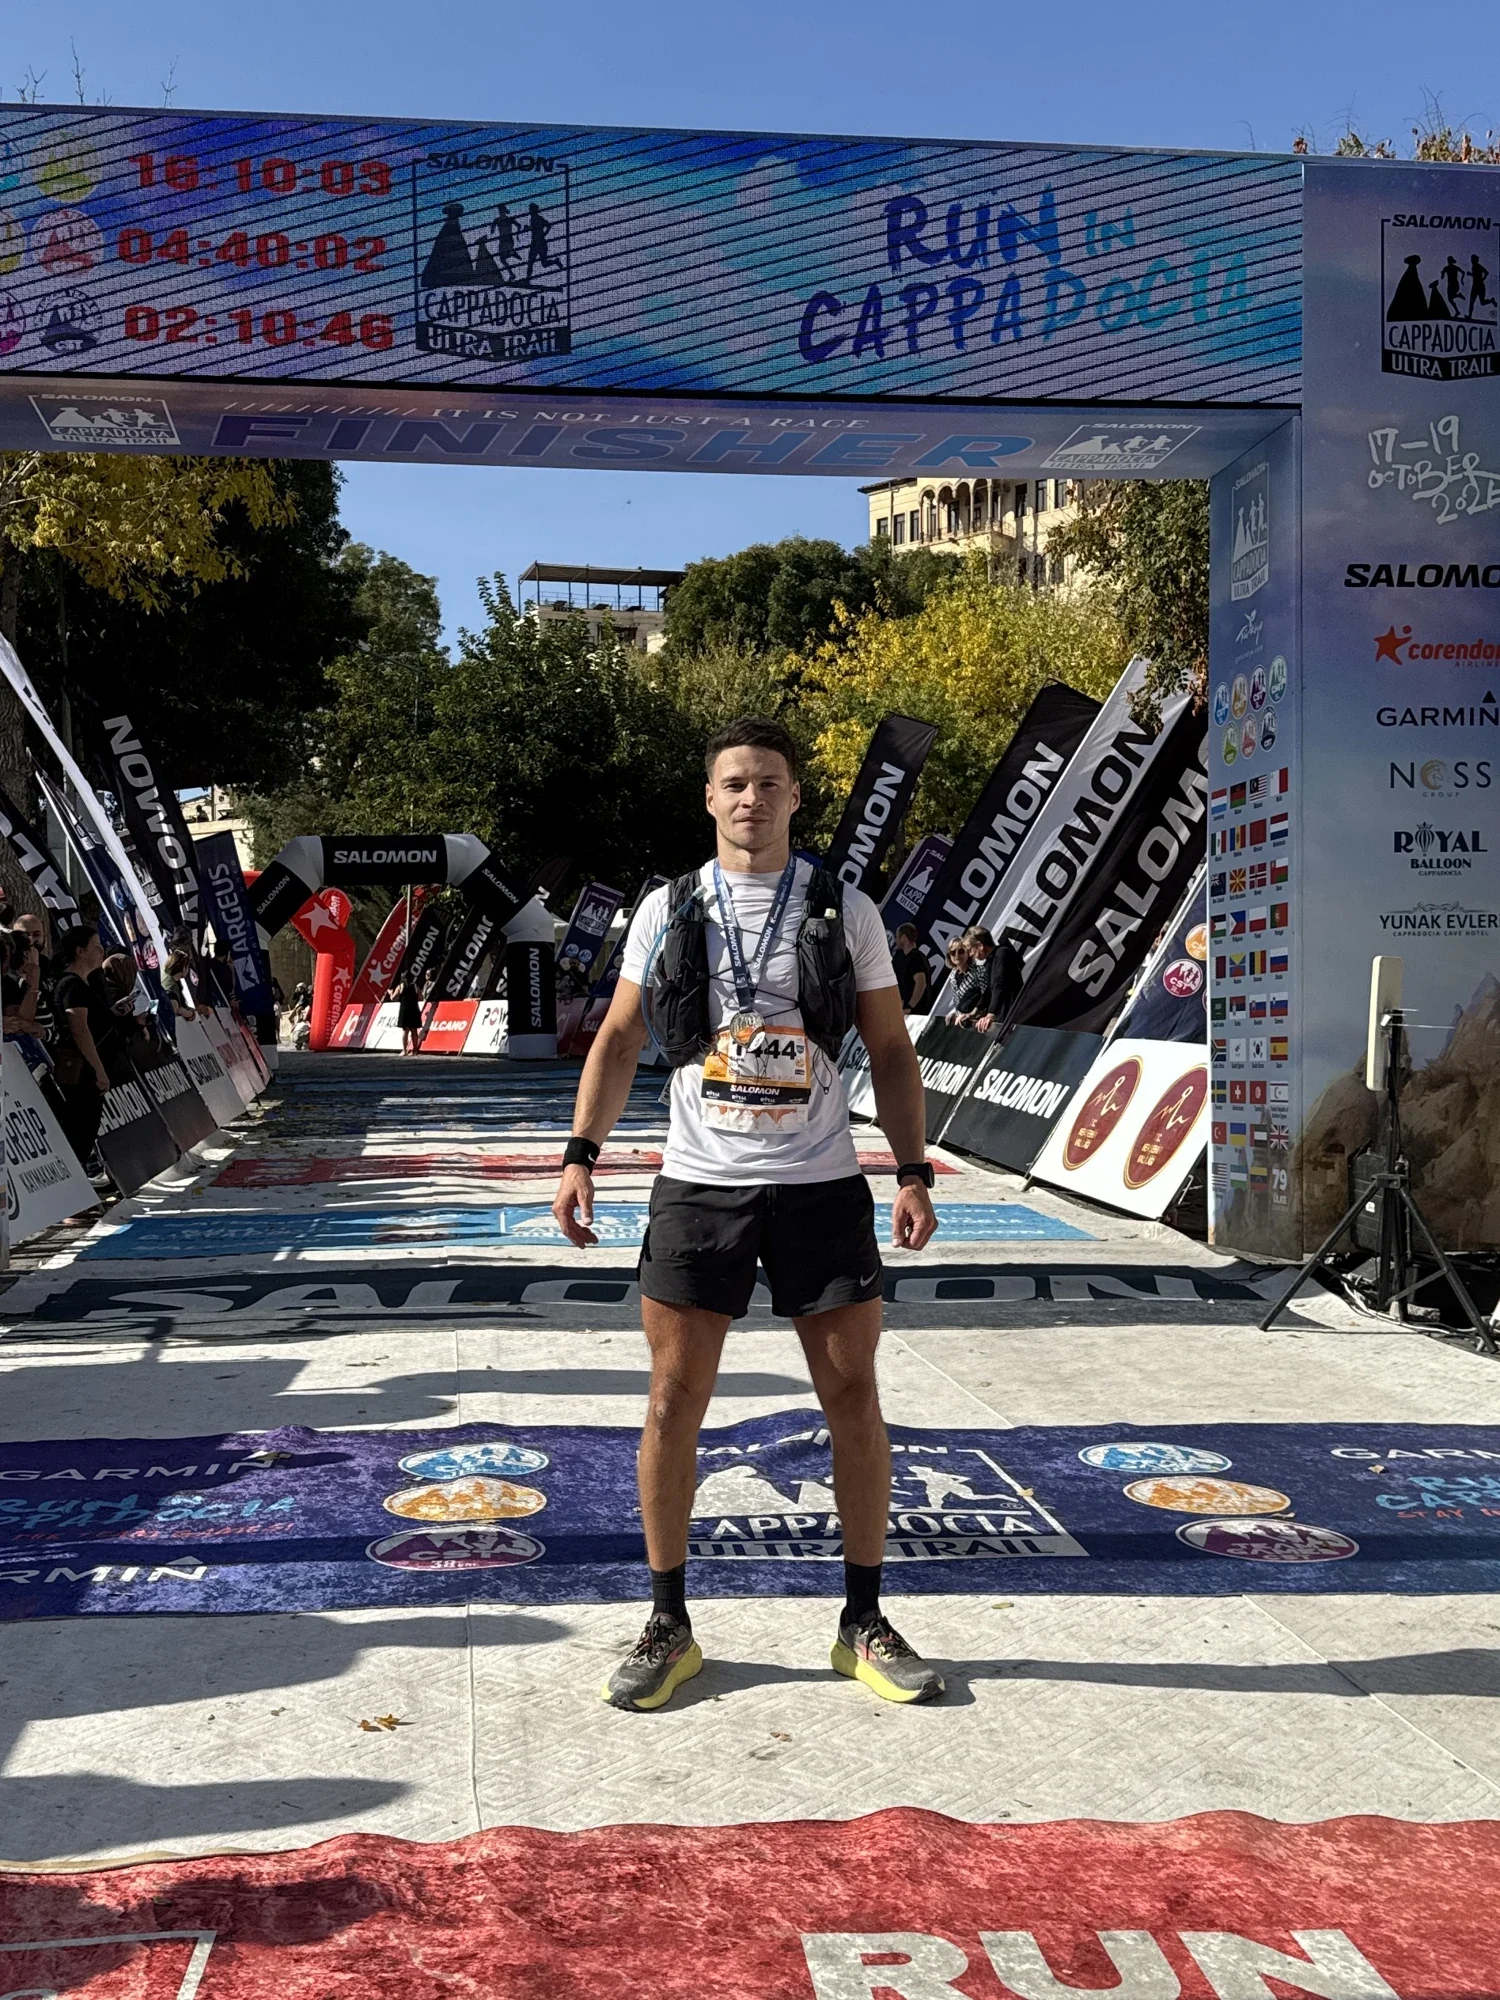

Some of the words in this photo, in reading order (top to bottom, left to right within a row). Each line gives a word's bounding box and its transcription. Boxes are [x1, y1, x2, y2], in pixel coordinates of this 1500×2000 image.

[129, 153, 392, 196] 16:10:03
[426, 152, 555, 173] SALOMON
[882, 182, 1062, 273] RUN
[1084, 206, 1137, 258] IN
[1392, 213, 1492, 231] SALOMON
[117, 228, 387, 273] 04:40:02
[425, 290, 561, 327] CAPPADOCIA
[798, 246, 1253, 364] CAPPADOCIA
[125, 306, 394, 349] 02:10:46
[427, 326, 494, 359] ULTRA
[501, 330, 557, 357] TRAIL
[1388, 323, 1496, 354] CAPPADOCIA
[1391, 353, 1443, 378] ULTRA
[1449, 356, 1495, 378] TRAIL
[41, 393, 153, 403] SALOMON
[55, 427, 171, 440] CAPPADOCIA
[431, 408, 469, 418] IT
[483, 410, 518, 420] IS
[533, 411, 611, 423] NOT
[621, 414, 719, 426] JUST
[728, 416, 752, 427] A
[768, 417, 869, 429] RACE
[1091, 423, 1194, 431] SALOMON
[62, 435, 116, 444] ULTRA
[125, 437, 168, 445] TRAIL
[209, 413, 1037, 469] FINISHER
[1050, 461, 1097, 470] ULTRA
[1103, 462, 1148, 470] TRAIL
[1053, 453, 1157, 464] CAPPADOCIA
[1234, 461, 1267, 491] SALOMON
[1233, 547, 1266, 582] CAPPADOCIA
[1233, 582, 1250, 598] ULTRA
[1250, 569, 1267, 593] TRAIL
[1376, 706, 1500, 726] GARMIN
[333, 849, 438, 864] SALOMON
[1410, 858, 1472, 869] BALLOON
[255, 874, 291, 916] SALOMON
[482, 868, 520, 904] SALOMON
[208, 862, 250, 952] ARGEUS
[1379, 914, 1442, 930] YUNAK
[728, 923, 742, 968] SALOMON
[753, 926, 774, 970] SALOMON
[529, 947, 542, 1028] SALOMON
[1169, 976, 1190, 991] CST
[144, 1060, 192, 1105] SALOMON
[187, 1051, 225, 1086] SALOMON
[730, 1084, 780, 1096] SALOMON
[974, 1069, 1071, 1119] SALOMON
[1272, 1168, 1287, 1190] 79
[100, 1273, 1204, 1314] SALOON
[0, 1459, 274, 1482] GARMIN
[408, 1550, 497, 1561] CST
[890, 1538, 1056, 1558] TRAIL
[800, 1928, 1401, 2000] RUN
